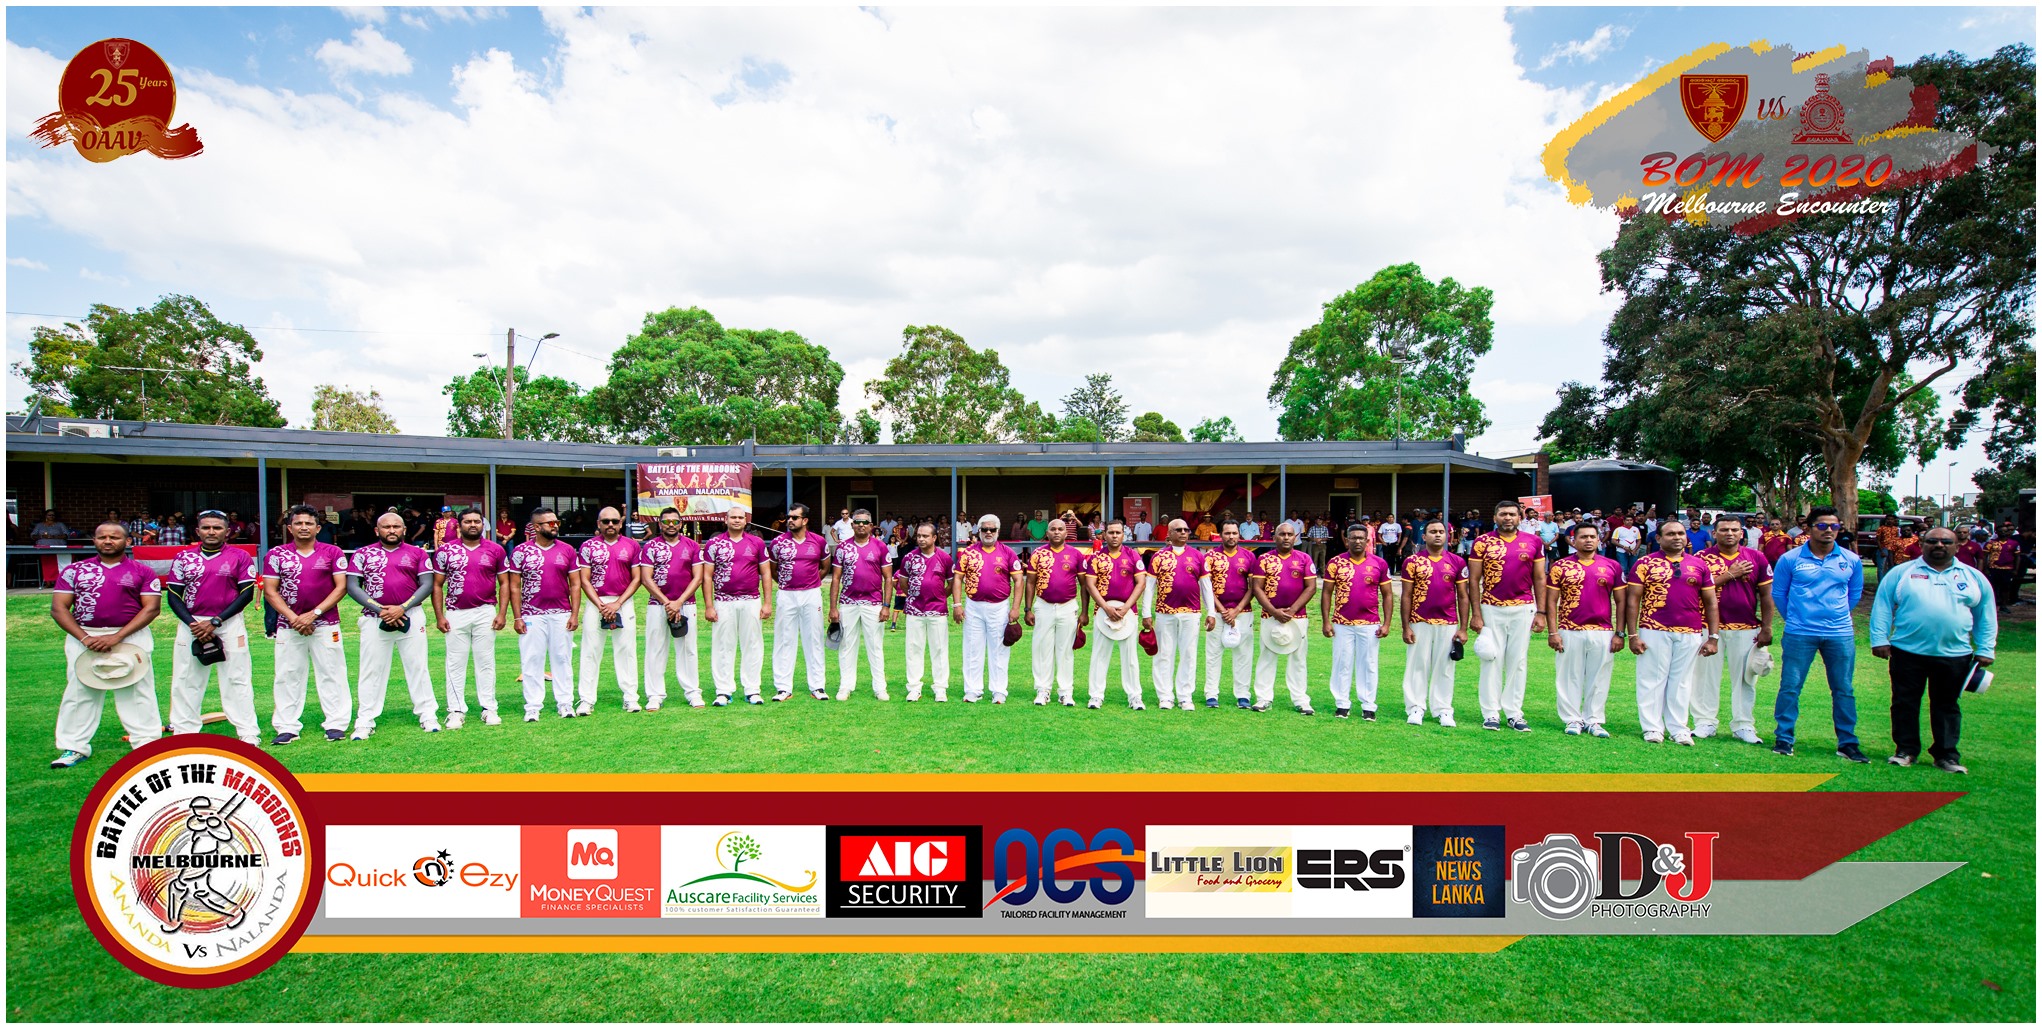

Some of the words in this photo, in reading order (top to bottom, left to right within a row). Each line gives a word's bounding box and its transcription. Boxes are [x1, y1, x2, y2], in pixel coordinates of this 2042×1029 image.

[647, 465, 675, 474] BATTLE
[675, 465, 686, 474] OF
[686, 464, 700, 473] THE
[702, 464, 740, 474] MAROONS
[658, 488, 688, 496] ANANDA
[695, 488, 731, 496] NALANDA
